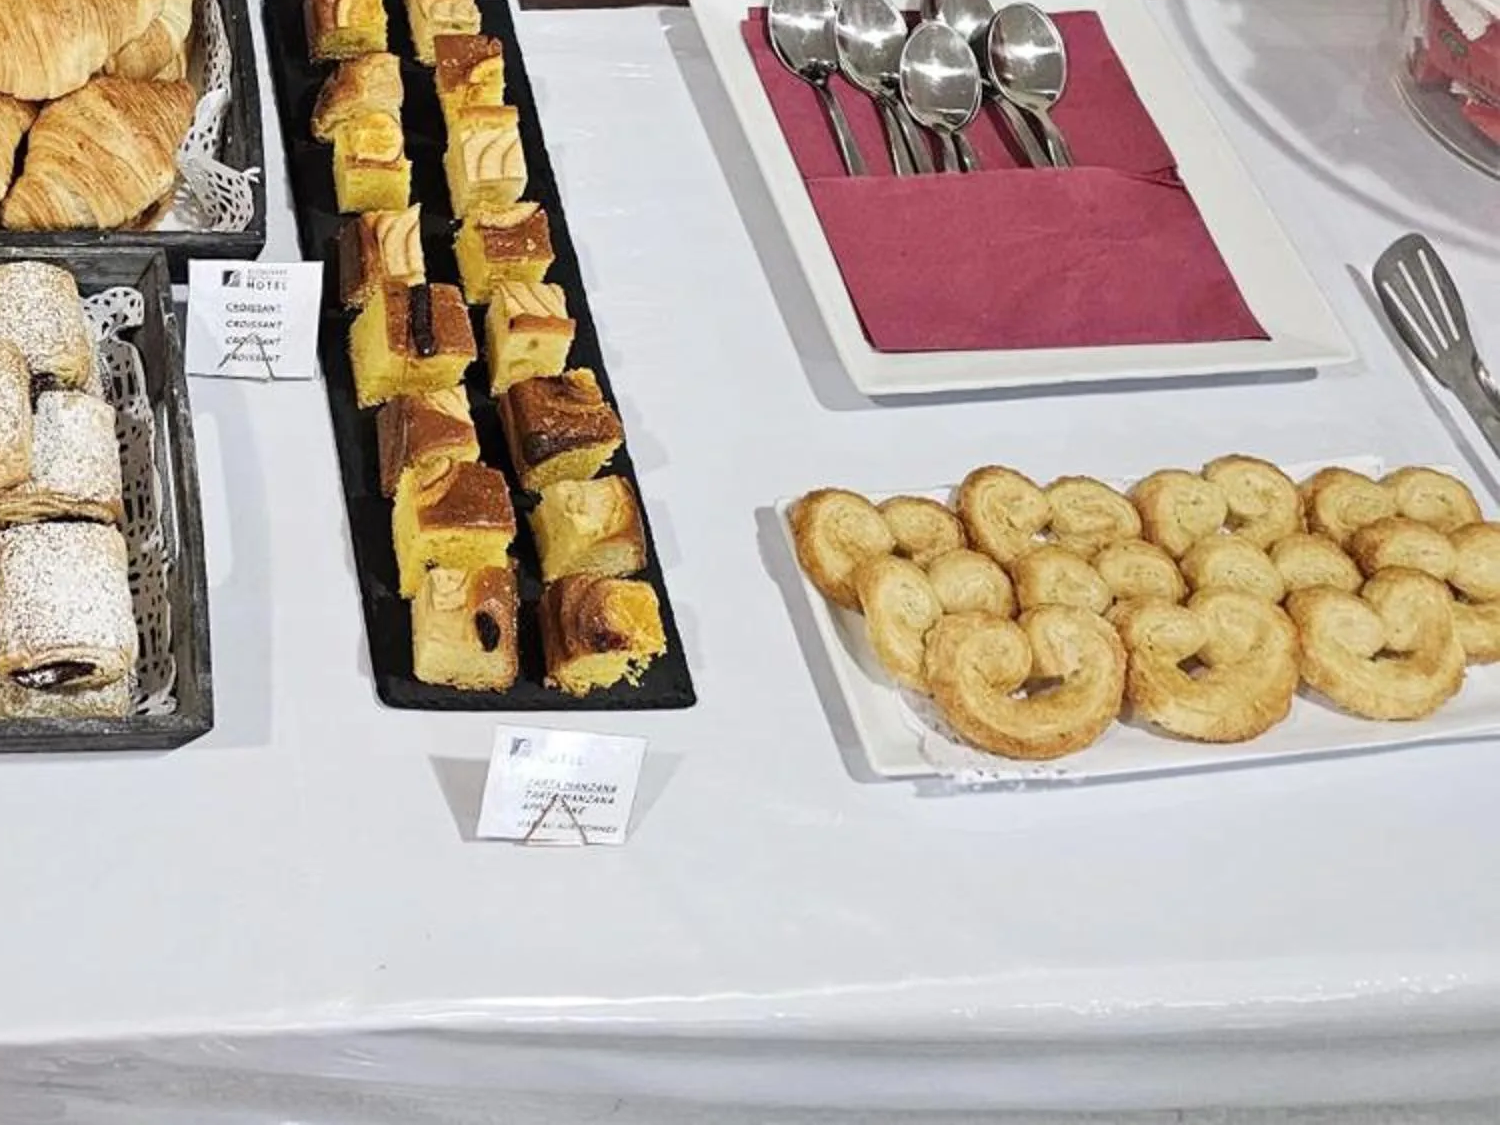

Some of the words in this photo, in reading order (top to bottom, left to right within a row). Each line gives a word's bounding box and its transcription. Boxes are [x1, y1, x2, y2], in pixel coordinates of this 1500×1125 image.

[246, 281, 288, 292] HOTEL
[225, 302, 283, 314] CROISSANT
[225, 319, 284, 329] CROISSANT
